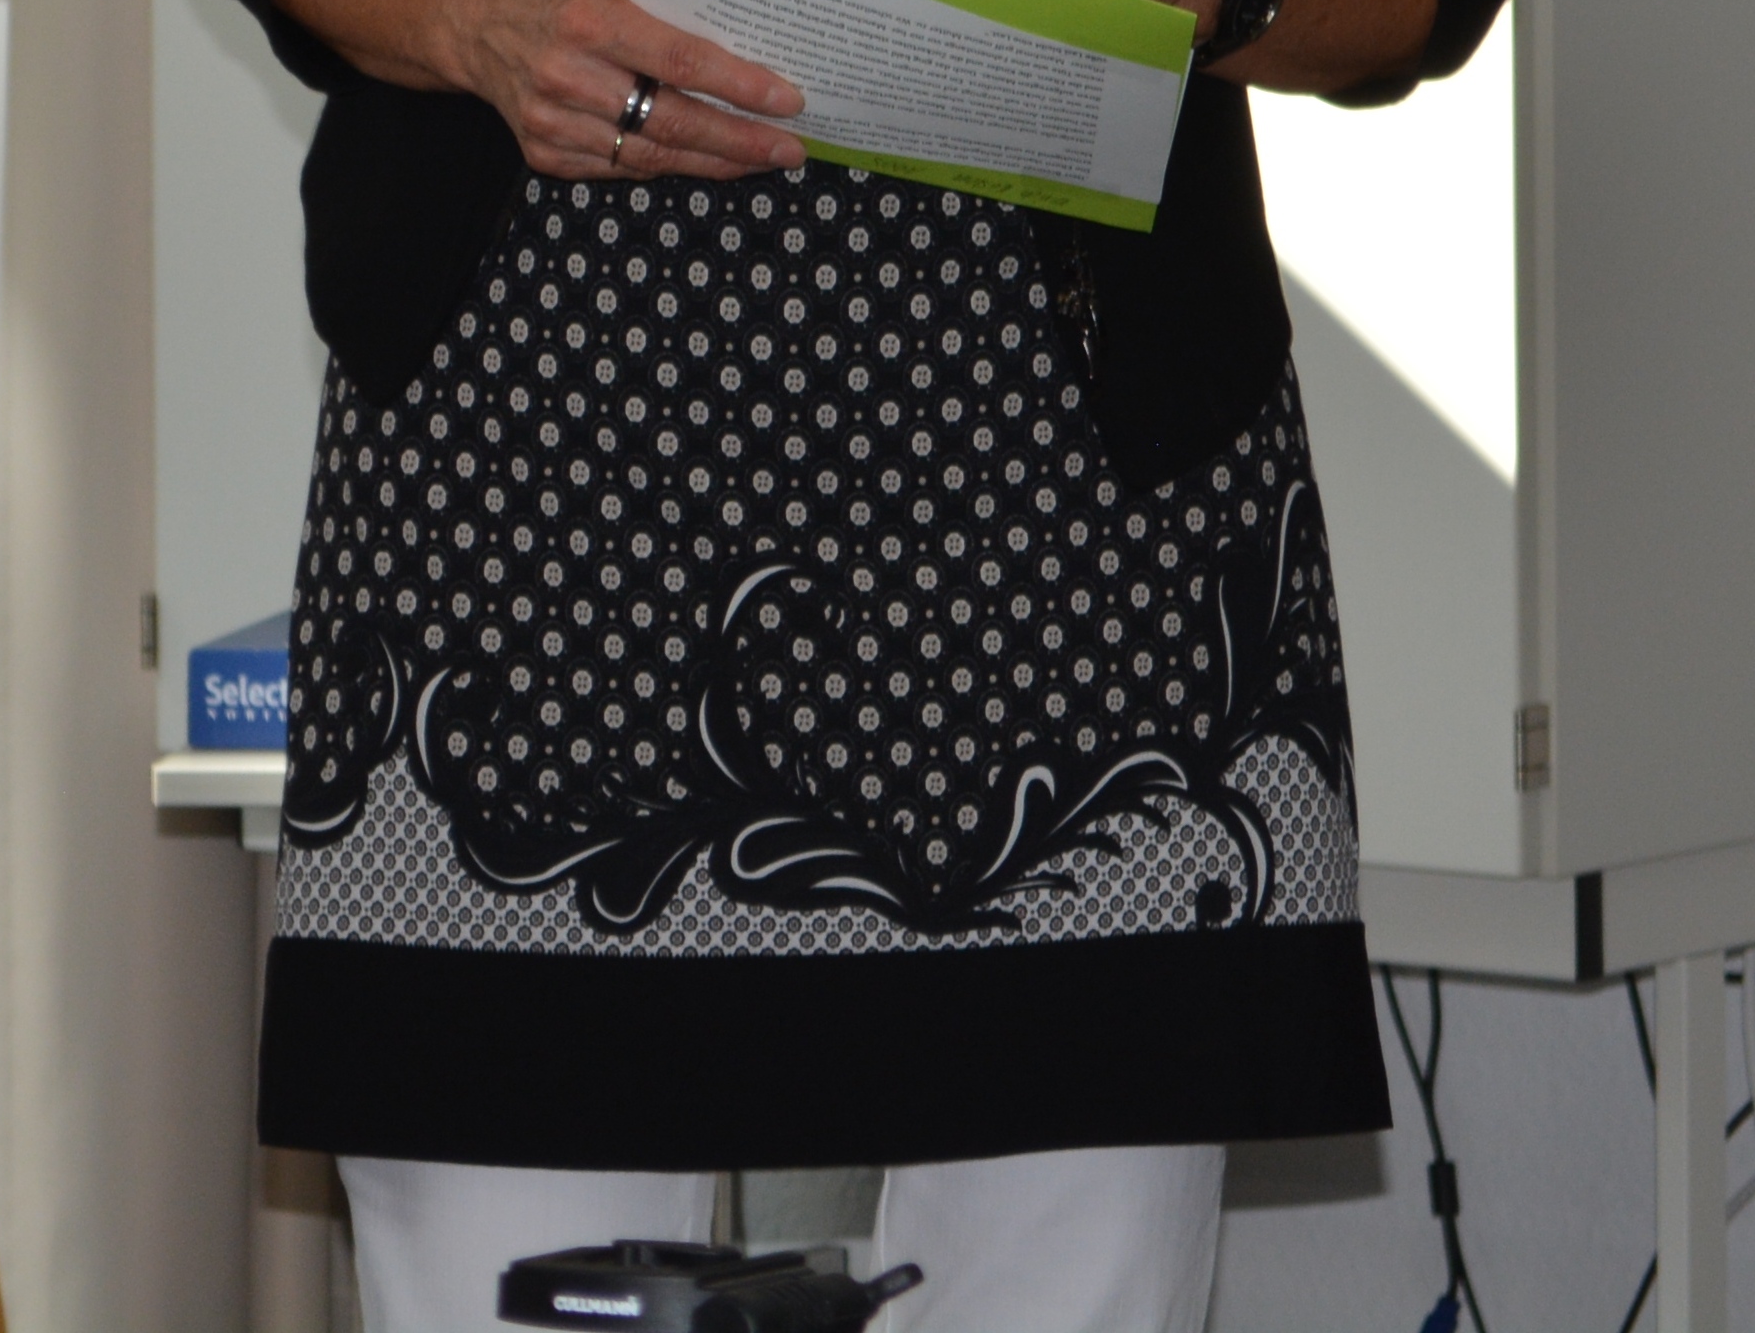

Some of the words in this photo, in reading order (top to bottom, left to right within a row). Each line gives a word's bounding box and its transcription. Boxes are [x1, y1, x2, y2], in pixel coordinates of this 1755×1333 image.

[773, 4, 795, 15] nach
[809, 2, 837, 15] setzte
[844, 1, 893, 19] schwitzten
[718, 10, 753, 27] rannten
[796, 10, 845, 30] gesprächig
[838, 12, 887, 31] Manchmal
[788, 22, 826, 38] Bremser
[846, 26, 889, 43] stiefelten
[929, 27, 962, 40] Mutter
[985, 31, 1011, 41] Last."
[774, 30, 851, 57] herzzerbrechend
[828, 33, 848, 44] Herr
[963, 35, 993, 47] meine
[1012, 36, 1033, 46] eine
[761, 38, 793, 53] Mutter
[891, 40, 947, 59] Zuckertüten
[944, 41, 1009, 63] Fahnenstange
[994, 44, 1014, 52] griff
[1035, 43, 1063, 54] bleibt
[795, 48, 827, 62] meiner
[852, 52, 889, 66] weinten
[890, 51, 912, 62] bald
[912, 55, 933, 65] ging
[1015, 49, 1065, 65] Manchmal
[1064, 49, 1083, 58] Last
[1085, 54, 1107, 62] süße
[782, 56, 814, 70] reichte
[829, 58, 874, 73] zwinkerte
[891, 63, 924, 75] Jungen
[986, 63, 1016, 75] Kinder
[1010, 58, 1031, 67] eine
[926, 71, 948, 80] paar
[952, 66, 977, 77] Doch
[1051, 67, 1072, 78] Tüte
[1074, 72, 1105, 83] meine
[836, 72, 895, 90] Kohleneimer
[903, 76, 941, 89] meinem
[961, 88, 1002, 101] vergnügt
[1017, 81, 1074, 96] aufgeregten
[932, 93, 965, 103] schwer
[1076, 93, 1102, 102] ihren
[1039, 105, 1099, 120] Nasenspitze!
[1041, 114, 1079, 126] hundert
[553, 1295, 641, 1317] CULLMANN
